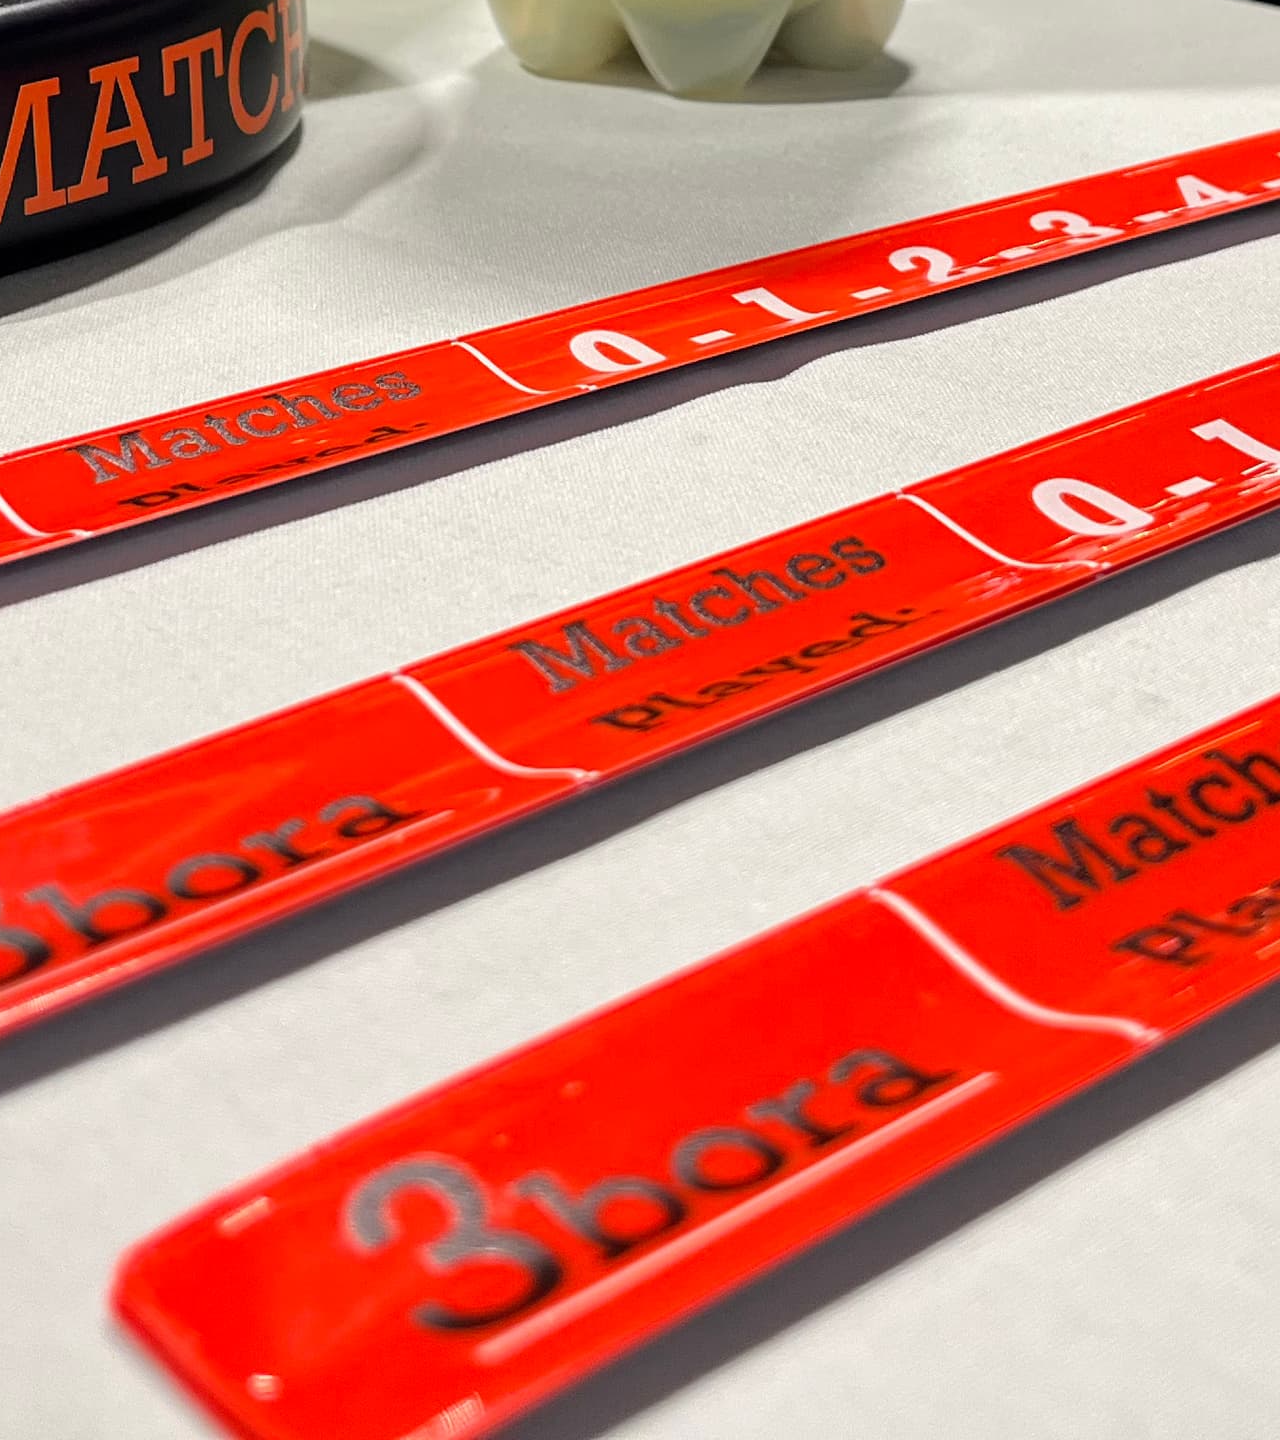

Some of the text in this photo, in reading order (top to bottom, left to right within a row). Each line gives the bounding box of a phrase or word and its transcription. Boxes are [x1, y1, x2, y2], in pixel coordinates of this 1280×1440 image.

[67, 371, 423, 484] Matches
[509, 536, 887, 694] Matches
[340, 1042, 957, 1334] 3bora
